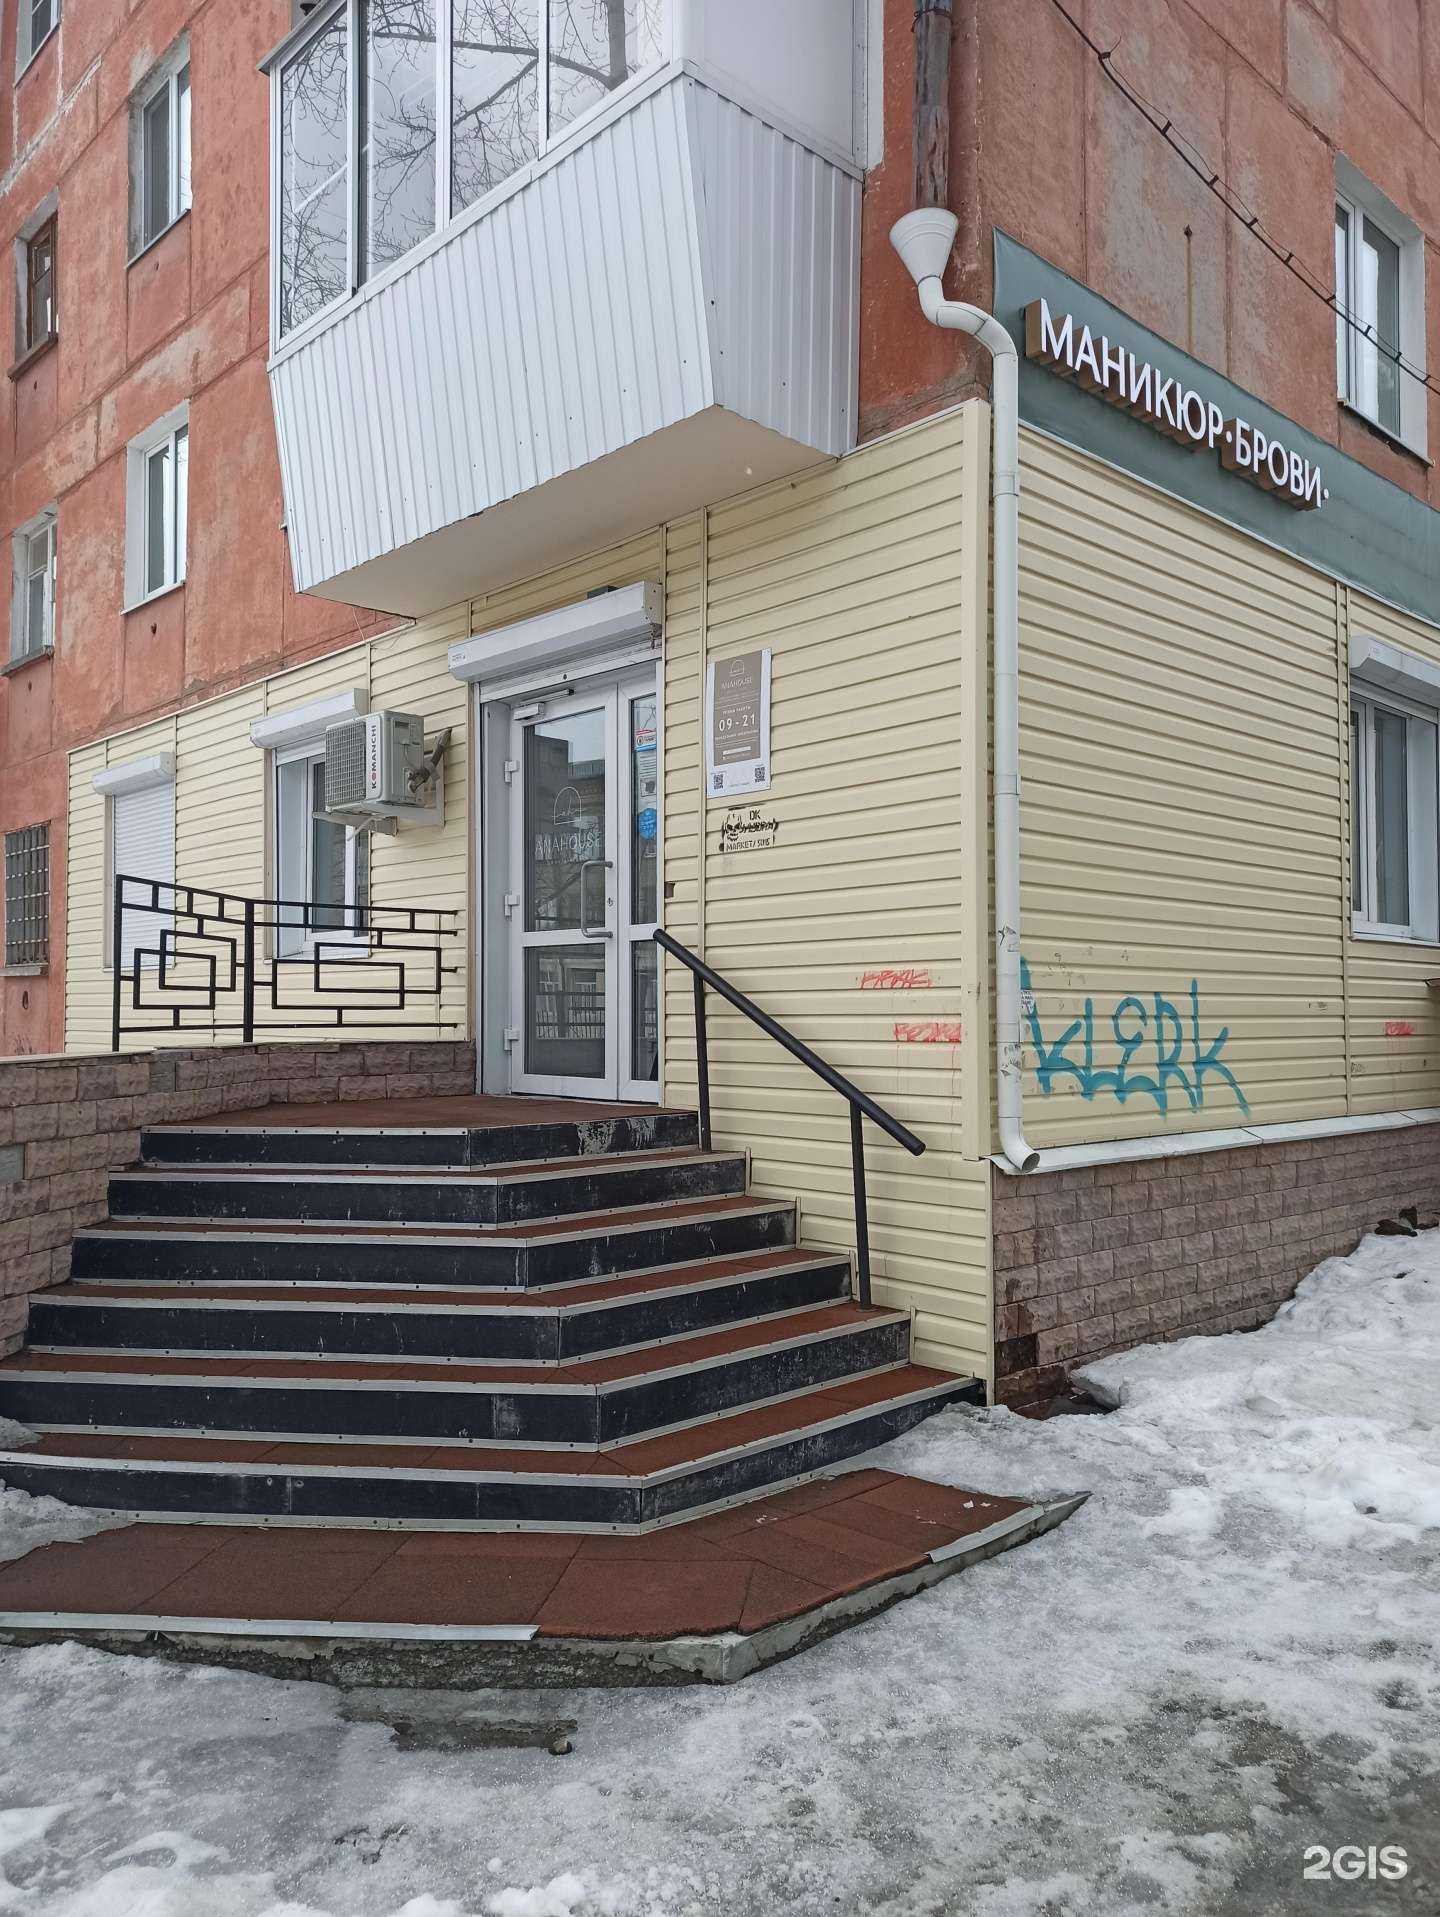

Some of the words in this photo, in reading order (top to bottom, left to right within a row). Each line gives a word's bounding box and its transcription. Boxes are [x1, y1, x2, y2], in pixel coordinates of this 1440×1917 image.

[718, 718, 733, 732] 09
[742, 713, 755, 727] 21
[535, 831, 602, 853] ANAHOUSE
